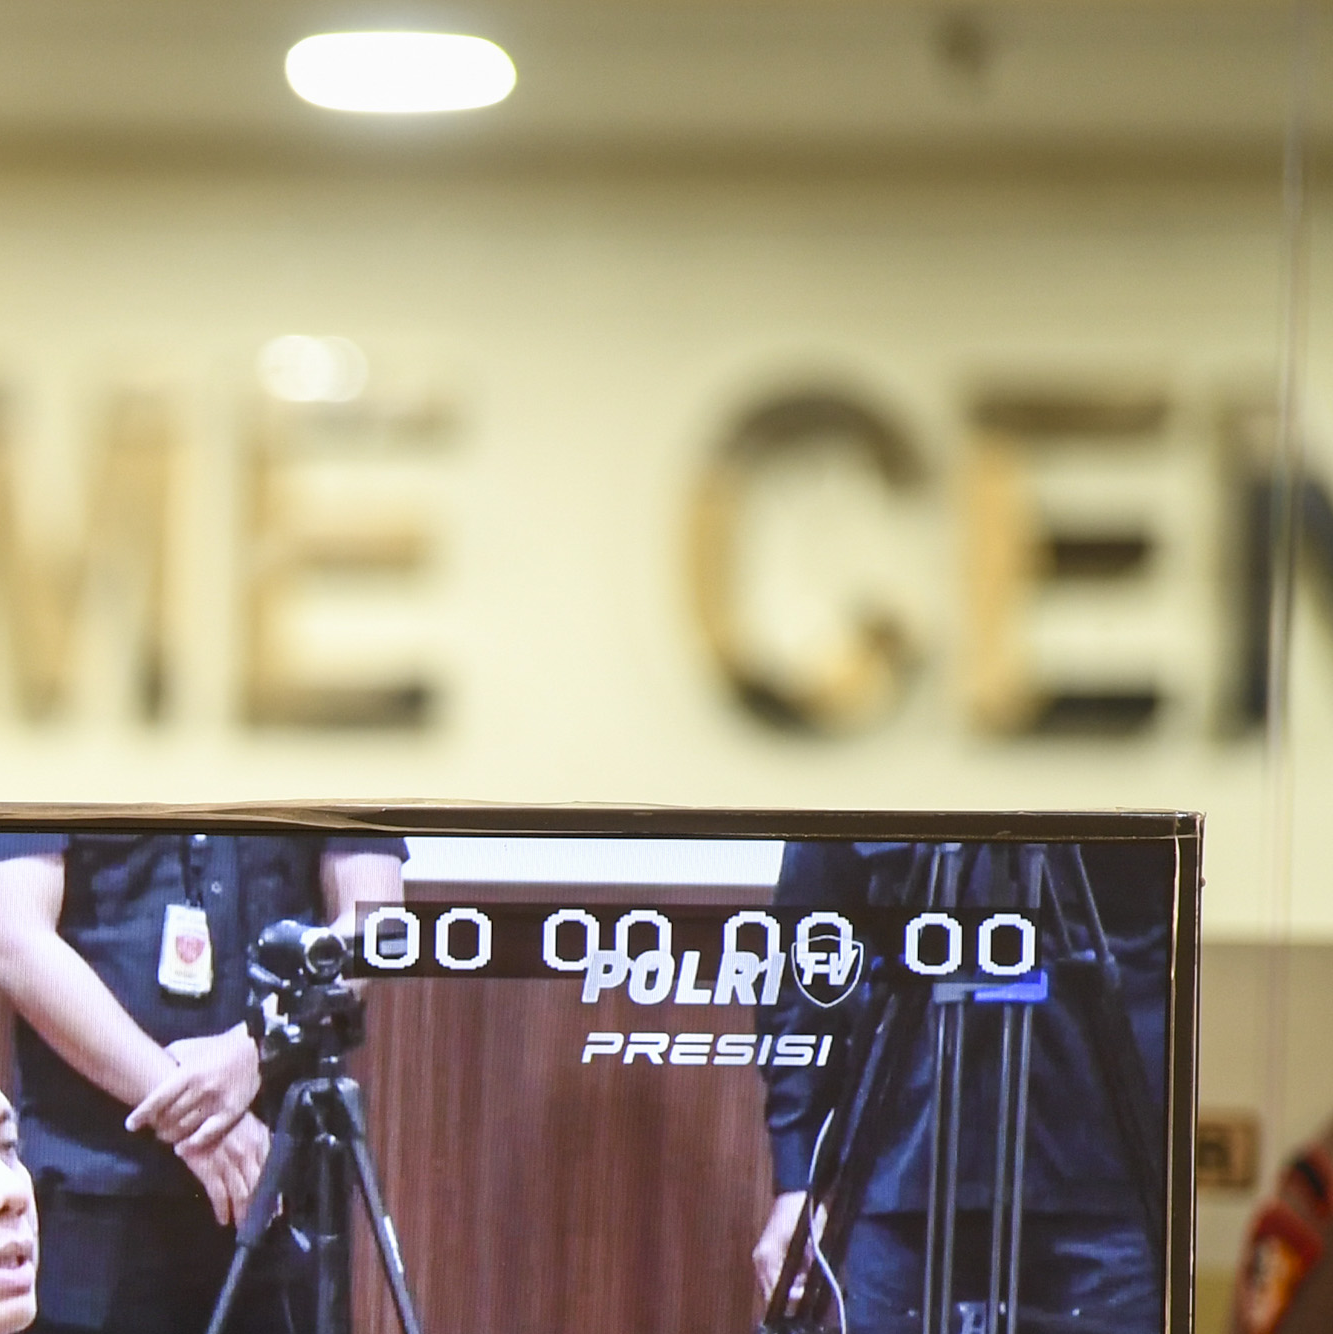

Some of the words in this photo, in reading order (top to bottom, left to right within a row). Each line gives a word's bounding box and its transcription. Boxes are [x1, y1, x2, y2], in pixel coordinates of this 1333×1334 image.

[582, 949, 786, 1006] POLRI
[800, 949, 859, 987] TV
[582, 1032, 833, 1067] PRESISI
